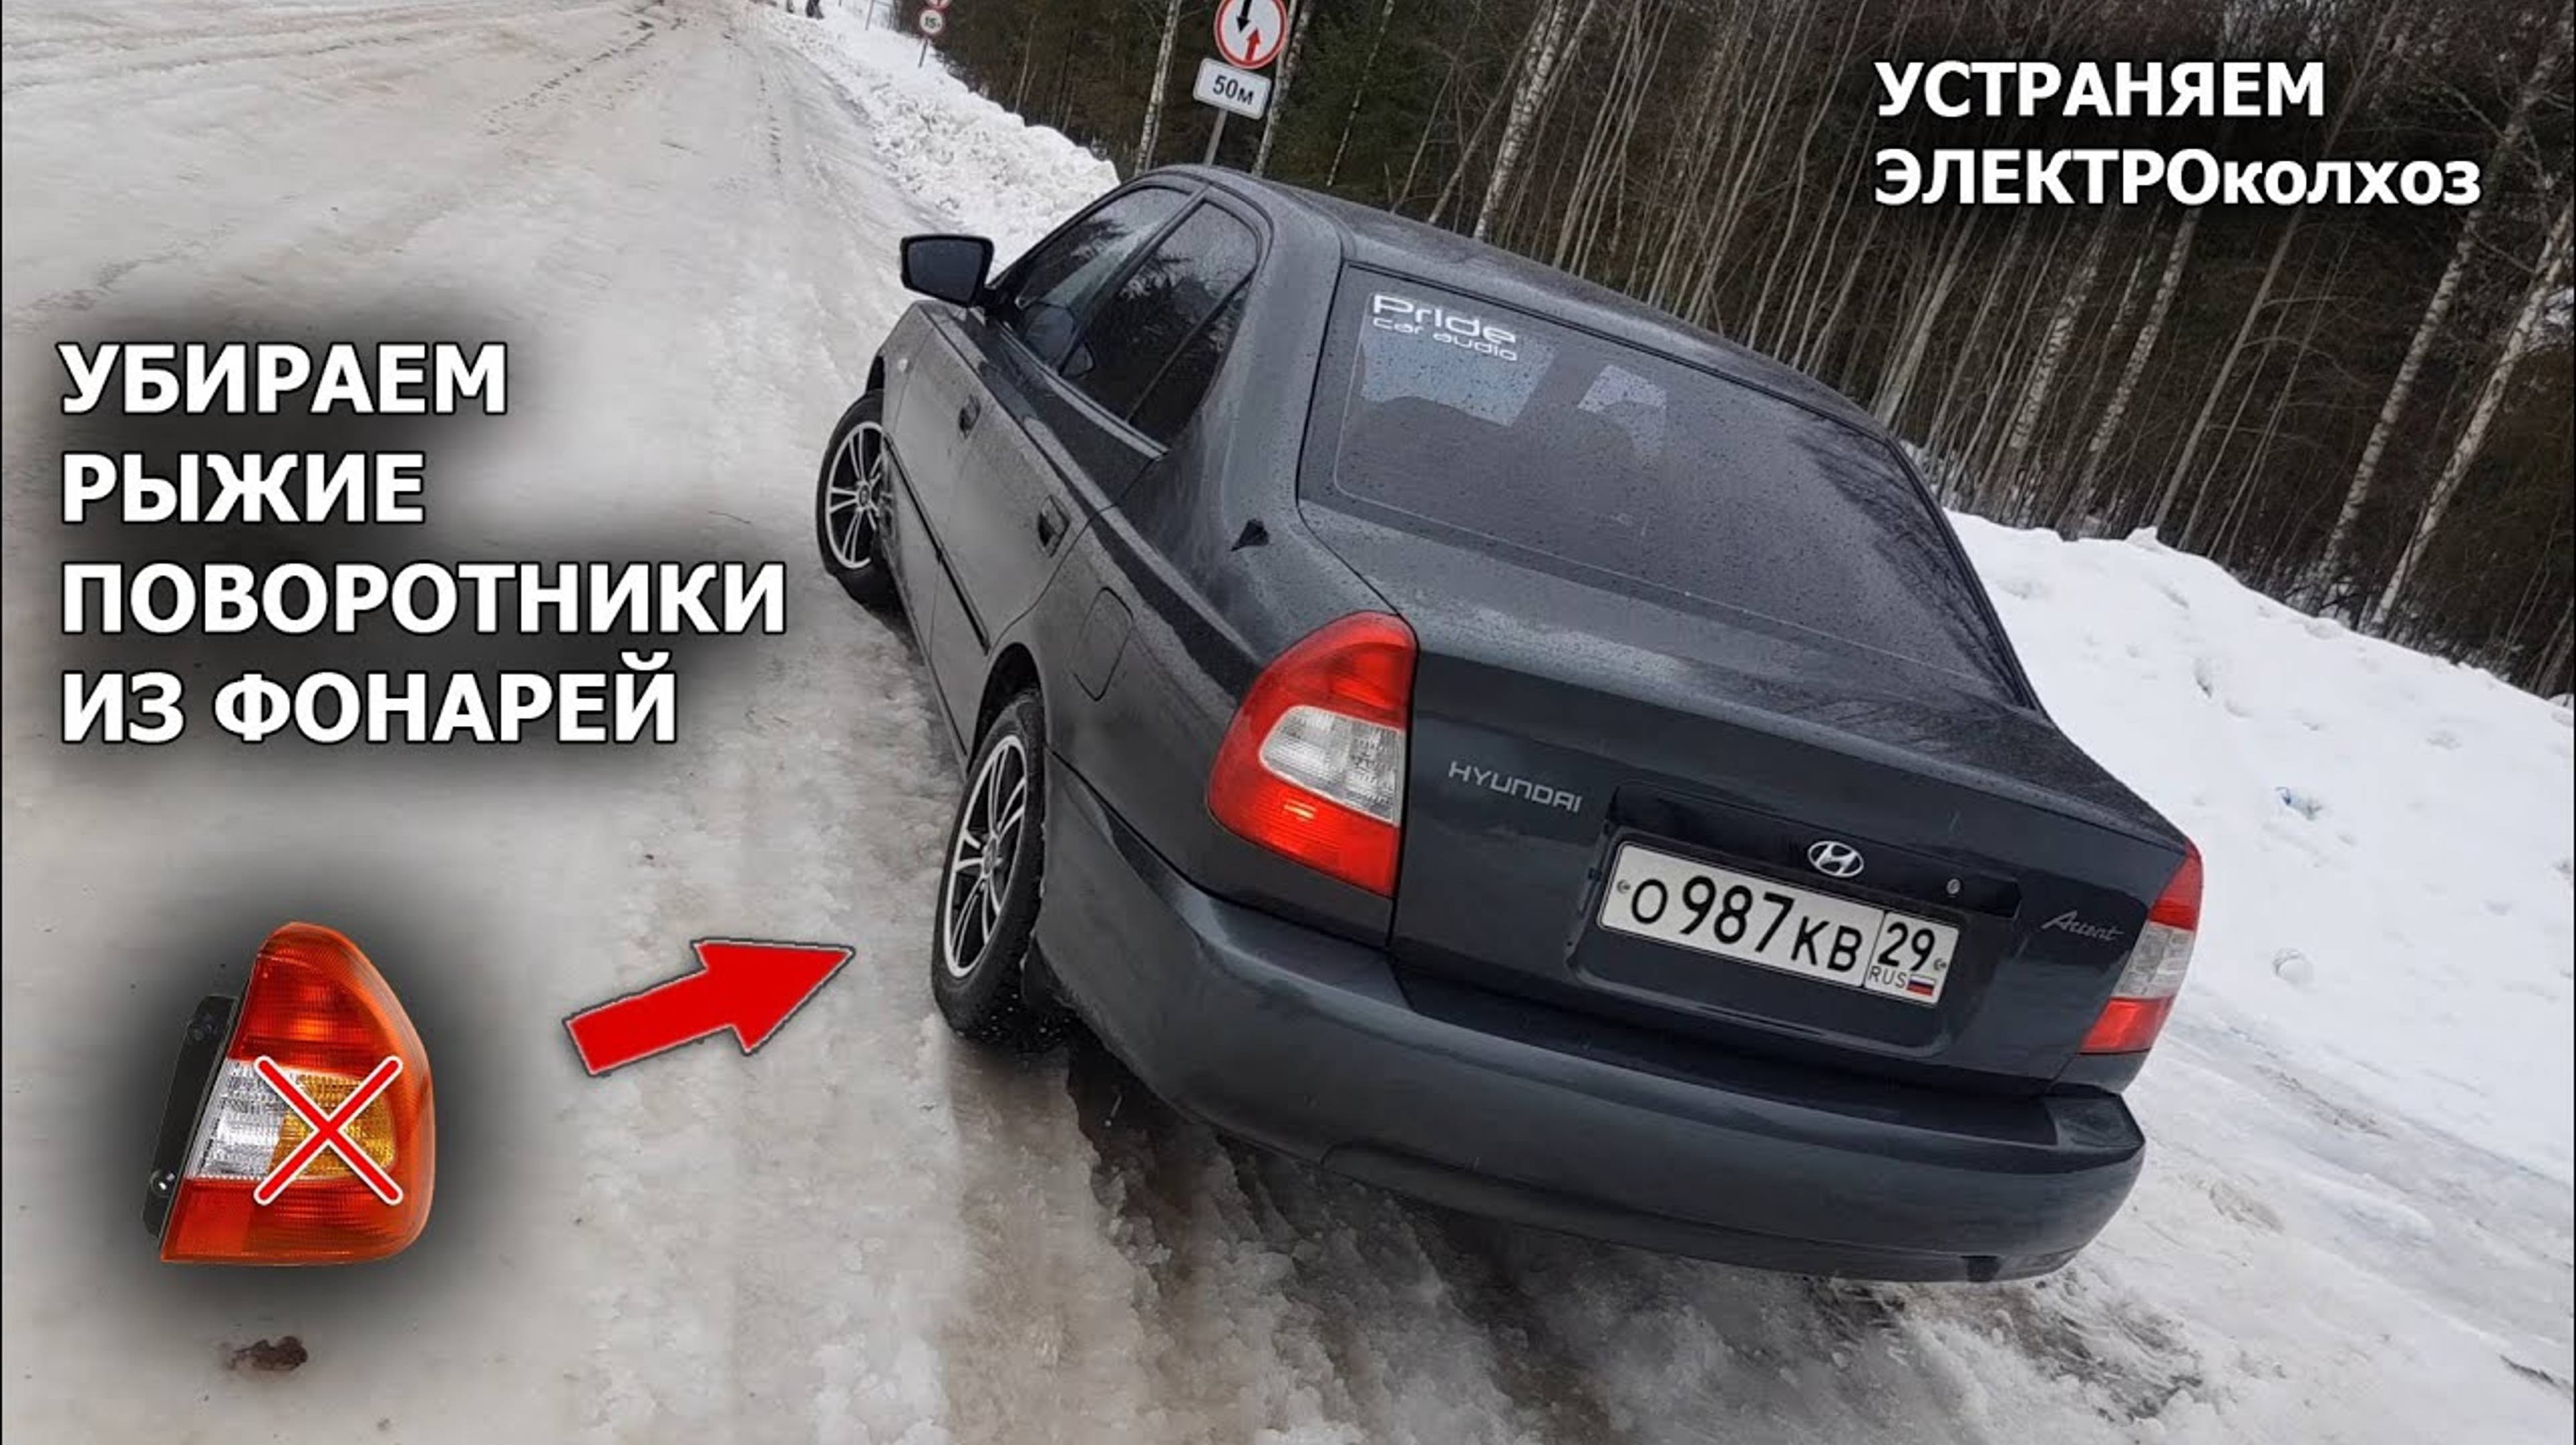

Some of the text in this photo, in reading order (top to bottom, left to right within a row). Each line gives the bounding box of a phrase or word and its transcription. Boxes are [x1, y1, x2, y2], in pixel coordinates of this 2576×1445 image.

[1432, 332, 1518, 362] audio
[1448, 761, 1582, 813] HYUNDAI
[1868, 965, 1907, 989] RUS
